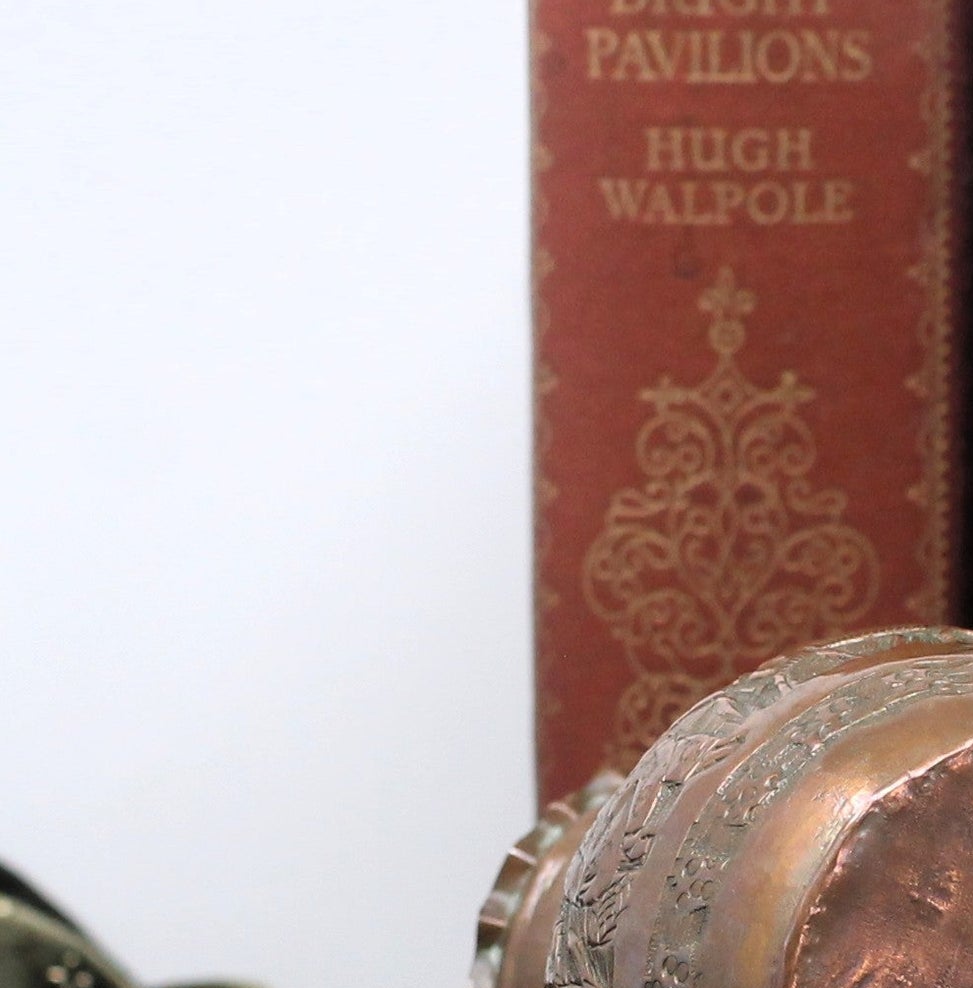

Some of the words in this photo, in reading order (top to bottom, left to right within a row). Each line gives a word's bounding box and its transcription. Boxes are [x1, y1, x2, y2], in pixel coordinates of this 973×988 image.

[586, 28, 873, 83] PAVILIONS
[645, 127, 813, 173] HUGH
[598, 178, 854, 226] WALPOLE
